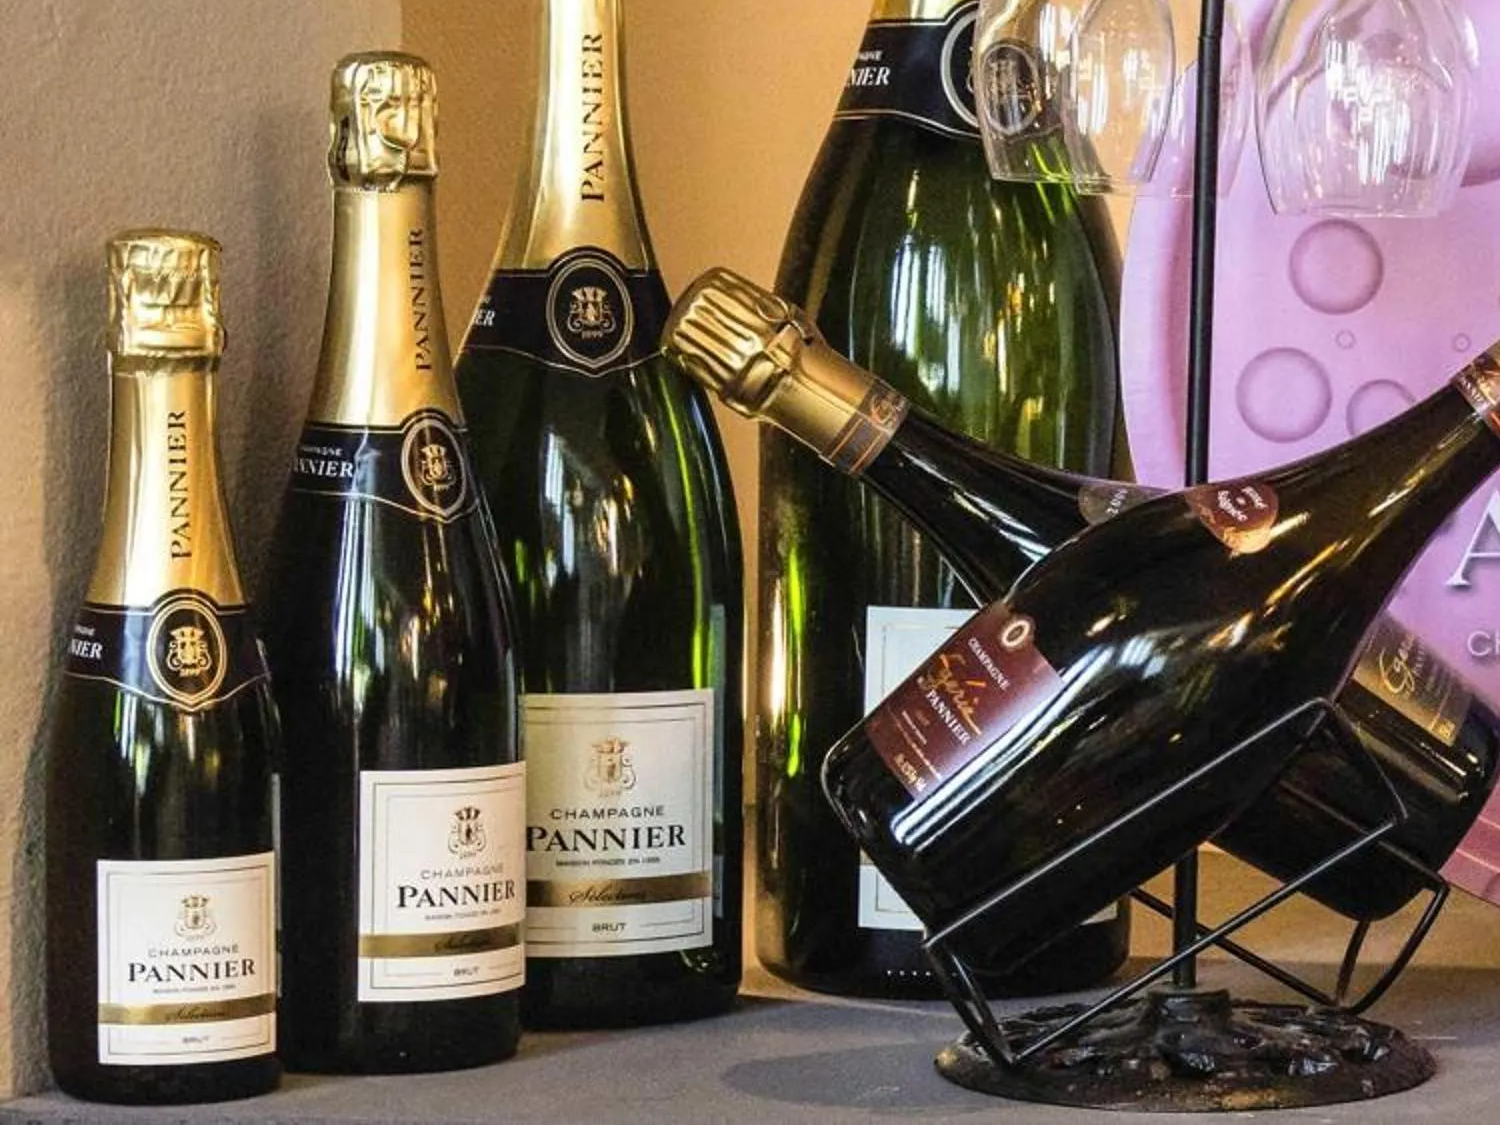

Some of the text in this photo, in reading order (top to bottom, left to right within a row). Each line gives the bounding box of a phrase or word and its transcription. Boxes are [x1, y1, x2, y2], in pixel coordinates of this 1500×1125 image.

[581, 33, 604, 203] PANNIER
[407, 228, 433, 371] PANNIER
[167, 410, 193, 560] PANNIER
[967, 637, 1012, 691] CHAMPAGNE
[925, 688, 972, 746] PANNIER
[549, 806, 665, 821] CHAMPAGNE
[526, 824, 687, 852] PANNIER
[420, 863, 504, 880] CHAMPAGNE
[396, 879, 516, 909] PANNIER
[591, 922, 627, 933] BRUT
[148, 944, 240, 959] CHAMPAGNE
[128, 958, 257, 983] PANNIER
